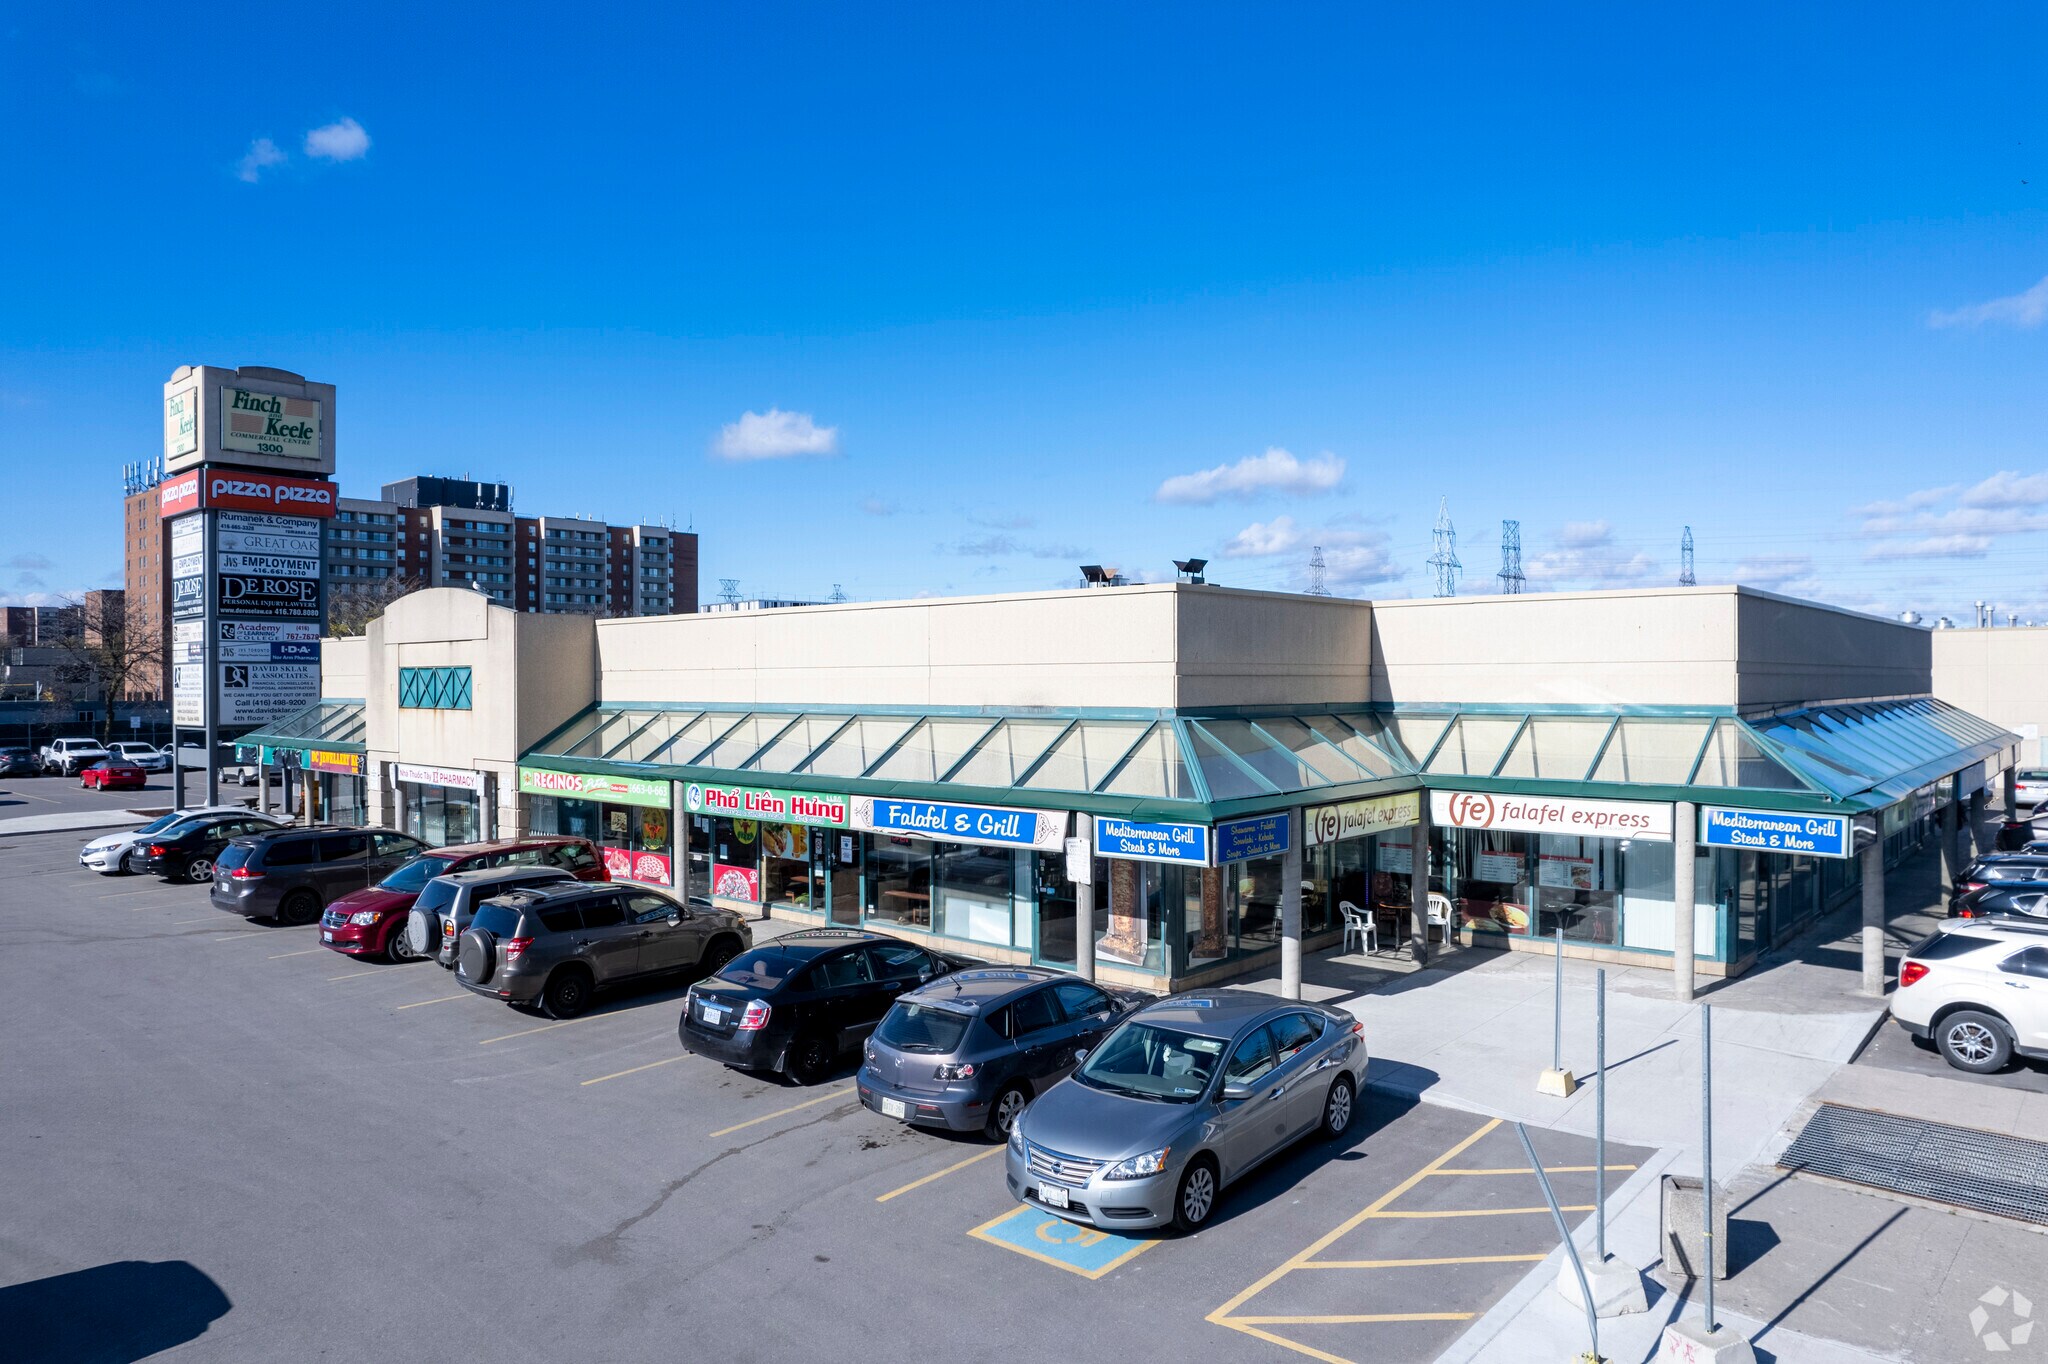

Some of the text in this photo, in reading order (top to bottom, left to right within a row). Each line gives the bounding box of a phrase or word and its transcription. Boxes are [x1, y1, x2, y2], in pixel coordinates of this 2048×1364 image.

[232, 390, 281, 414] Finch
[265, 418, 313, 440] Keele
[230, 432, 311, 446] COMMERCIAL CENTRE
[257, 443, 283, 453] 1300
[212, 479, 330, 504] pizza pizza
[220, 512, 318, 529] Rumanek & Company
[244, 536, 287, 549] GREAT
[290, 540, 318, 551] OAK
[242, 556, 317, 570] EMPLOYMENT
[237, 623, 280, 633] Academy
[440, 774, 475, 787] PHARMACY
[533, 772, 582, 791] REGINOS
[631, 784, 668, 796] 663-0-663
[746, 791, 784, 813] Liên
[889, 805, 1020, 838] Falafel & Grill
[1344, 806, 1375, 833] falafel
[1378, 805, 1411, 825] express
[1501, 802, 1564, 824] falafel
[1572, 810, 1650, 828] express
[1712, 812, 1837, 837] Mediterranean Grill
[1105, 822, 1195, 844] Mediterranean Grill
[1730, 830, 1815, 850] Steak & More
[1120, 839, 1180, 856] Steak & More
[1270, 842, 1280, 850] More
